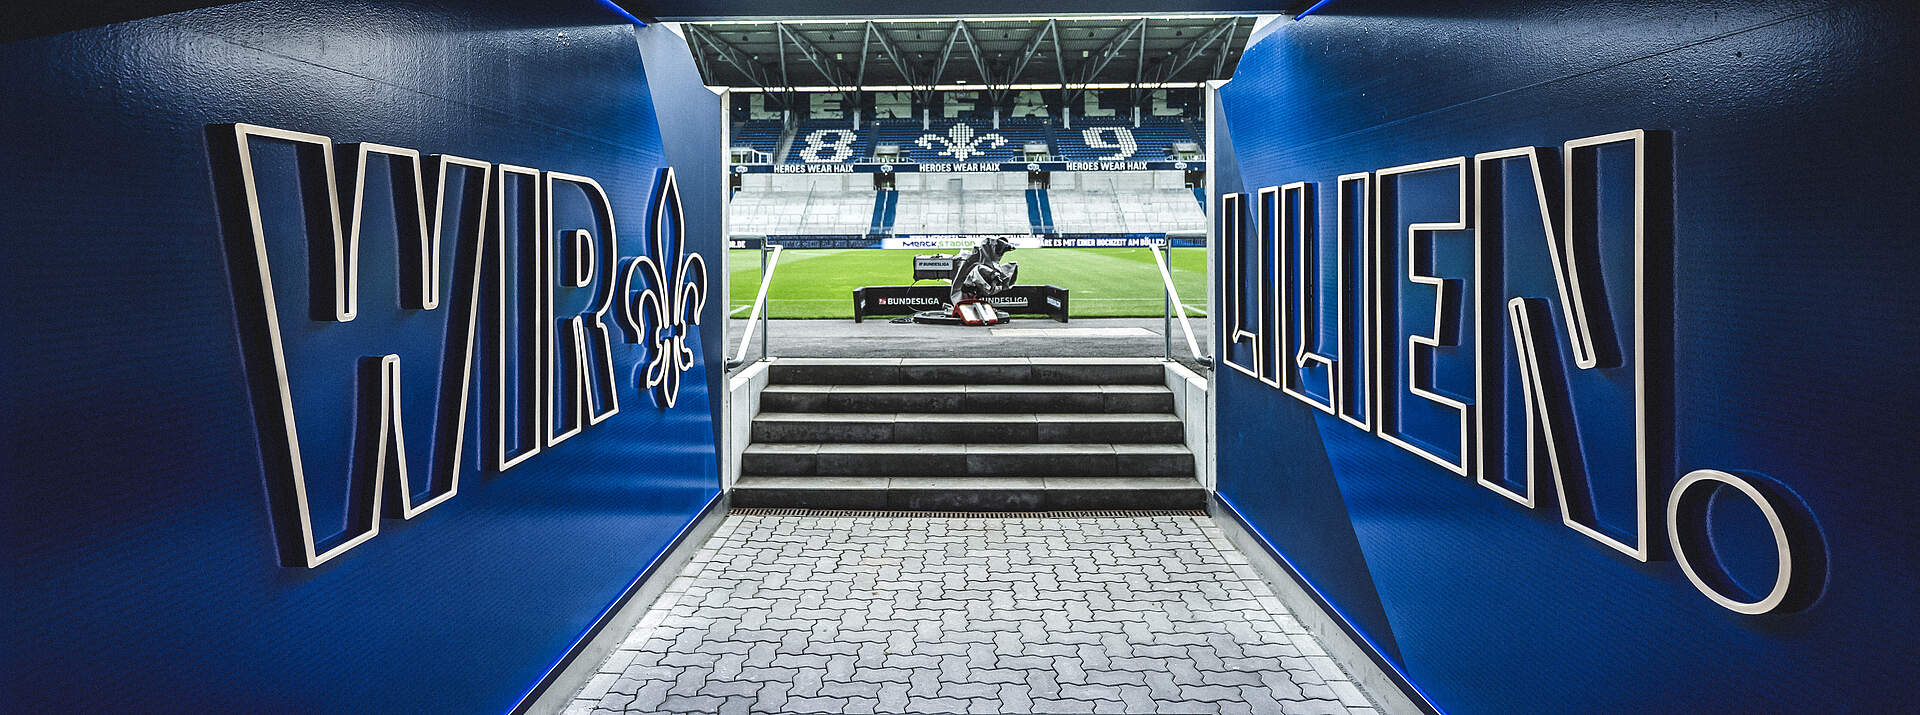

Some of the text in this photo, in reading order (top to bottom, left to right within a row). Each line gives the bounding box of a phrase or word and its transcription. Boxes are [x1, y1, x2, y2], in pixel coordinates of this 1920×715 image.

[800, 129, 857, 162] 8
[1082, 126, 1137, 160] 9
[773, 164, 854, 173] HEROES WEAR HAIX
[919, 163, 1000, 172] HEROES WEAR HAIX
[1066, 162, 1148, 171] HEROES WEAR HAIX
[1128, 239, 1140, 247] AM
[887, 297, 940, 305] BUNDESLIGA
[206, 122, 619, 568] WIR
[1222, 128, 1794, 614] LILIEN.
